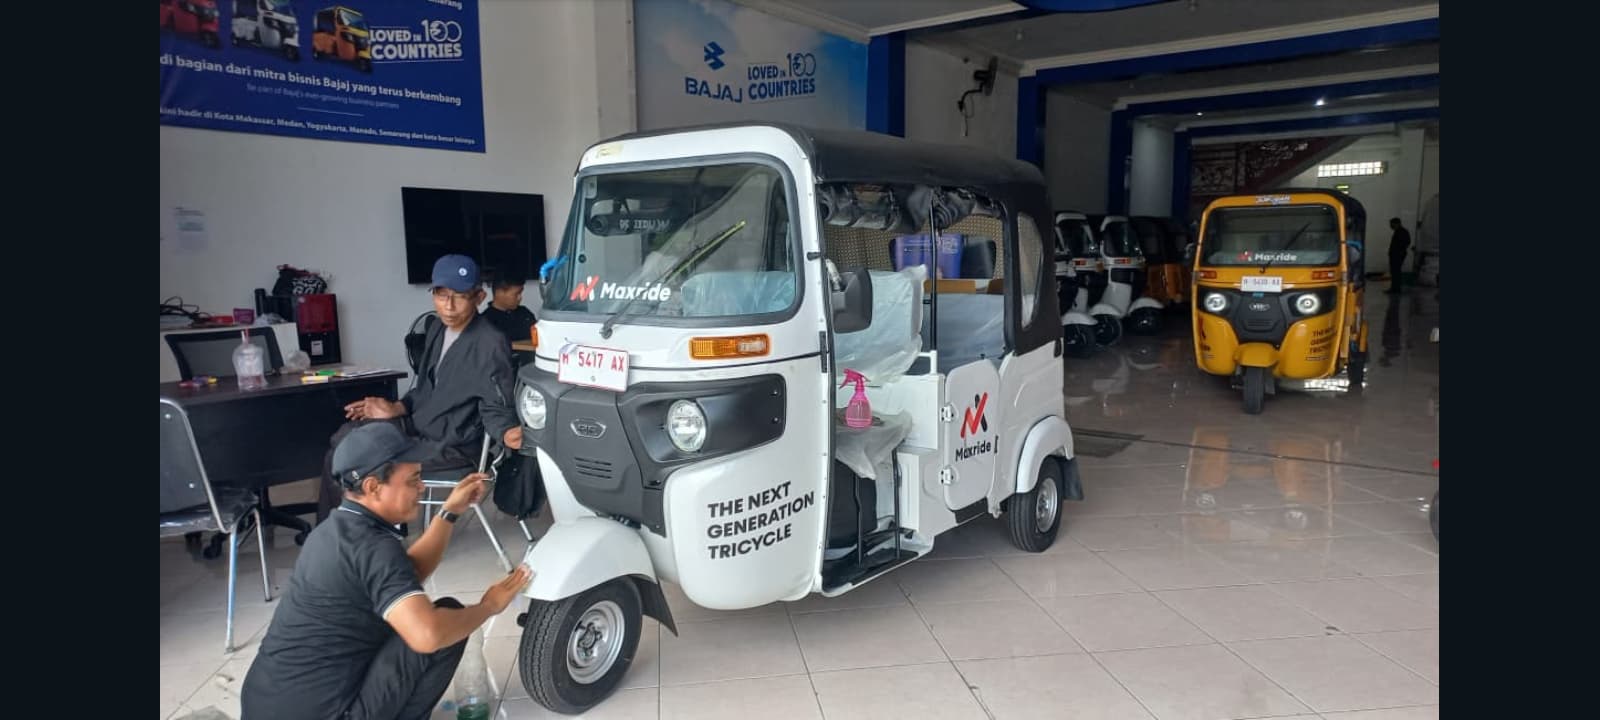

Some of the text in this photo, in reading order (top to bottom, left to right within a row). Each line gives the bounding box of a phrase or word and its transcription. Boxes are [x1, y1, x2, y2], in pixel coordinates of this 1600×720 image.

[369, 29, 412, 42] LOVED
[421, 19, 462, 42] 100
[371, 43, 463, 60] COUNTRIES
[748, 65, 778, 80] LOVED
[787, 53, 816, 77] 100
[160, 53, 462, 106] di bagian dari mitra bisnis Bajaj yang terus berkembang
[684, 76, 743, 103] BAJAJ
[748, 78, 816, 100] COUNTRIES
[178, 107, 203, 118] hadir
[204, 111, 213, 119] di
[214, 112, 235, 122] Kota
[600, 281, 672, 302] Maxride
[578, 351, 603, 368] 5417
[611, 356, 624, 371] AX
[955, 440, 992, 462] Maxride
[707, 481, 791, 518] THE NEXT
[707, 491, 814, 539] GENERATION
[708, 523, 791, 559] TRICYCLE
